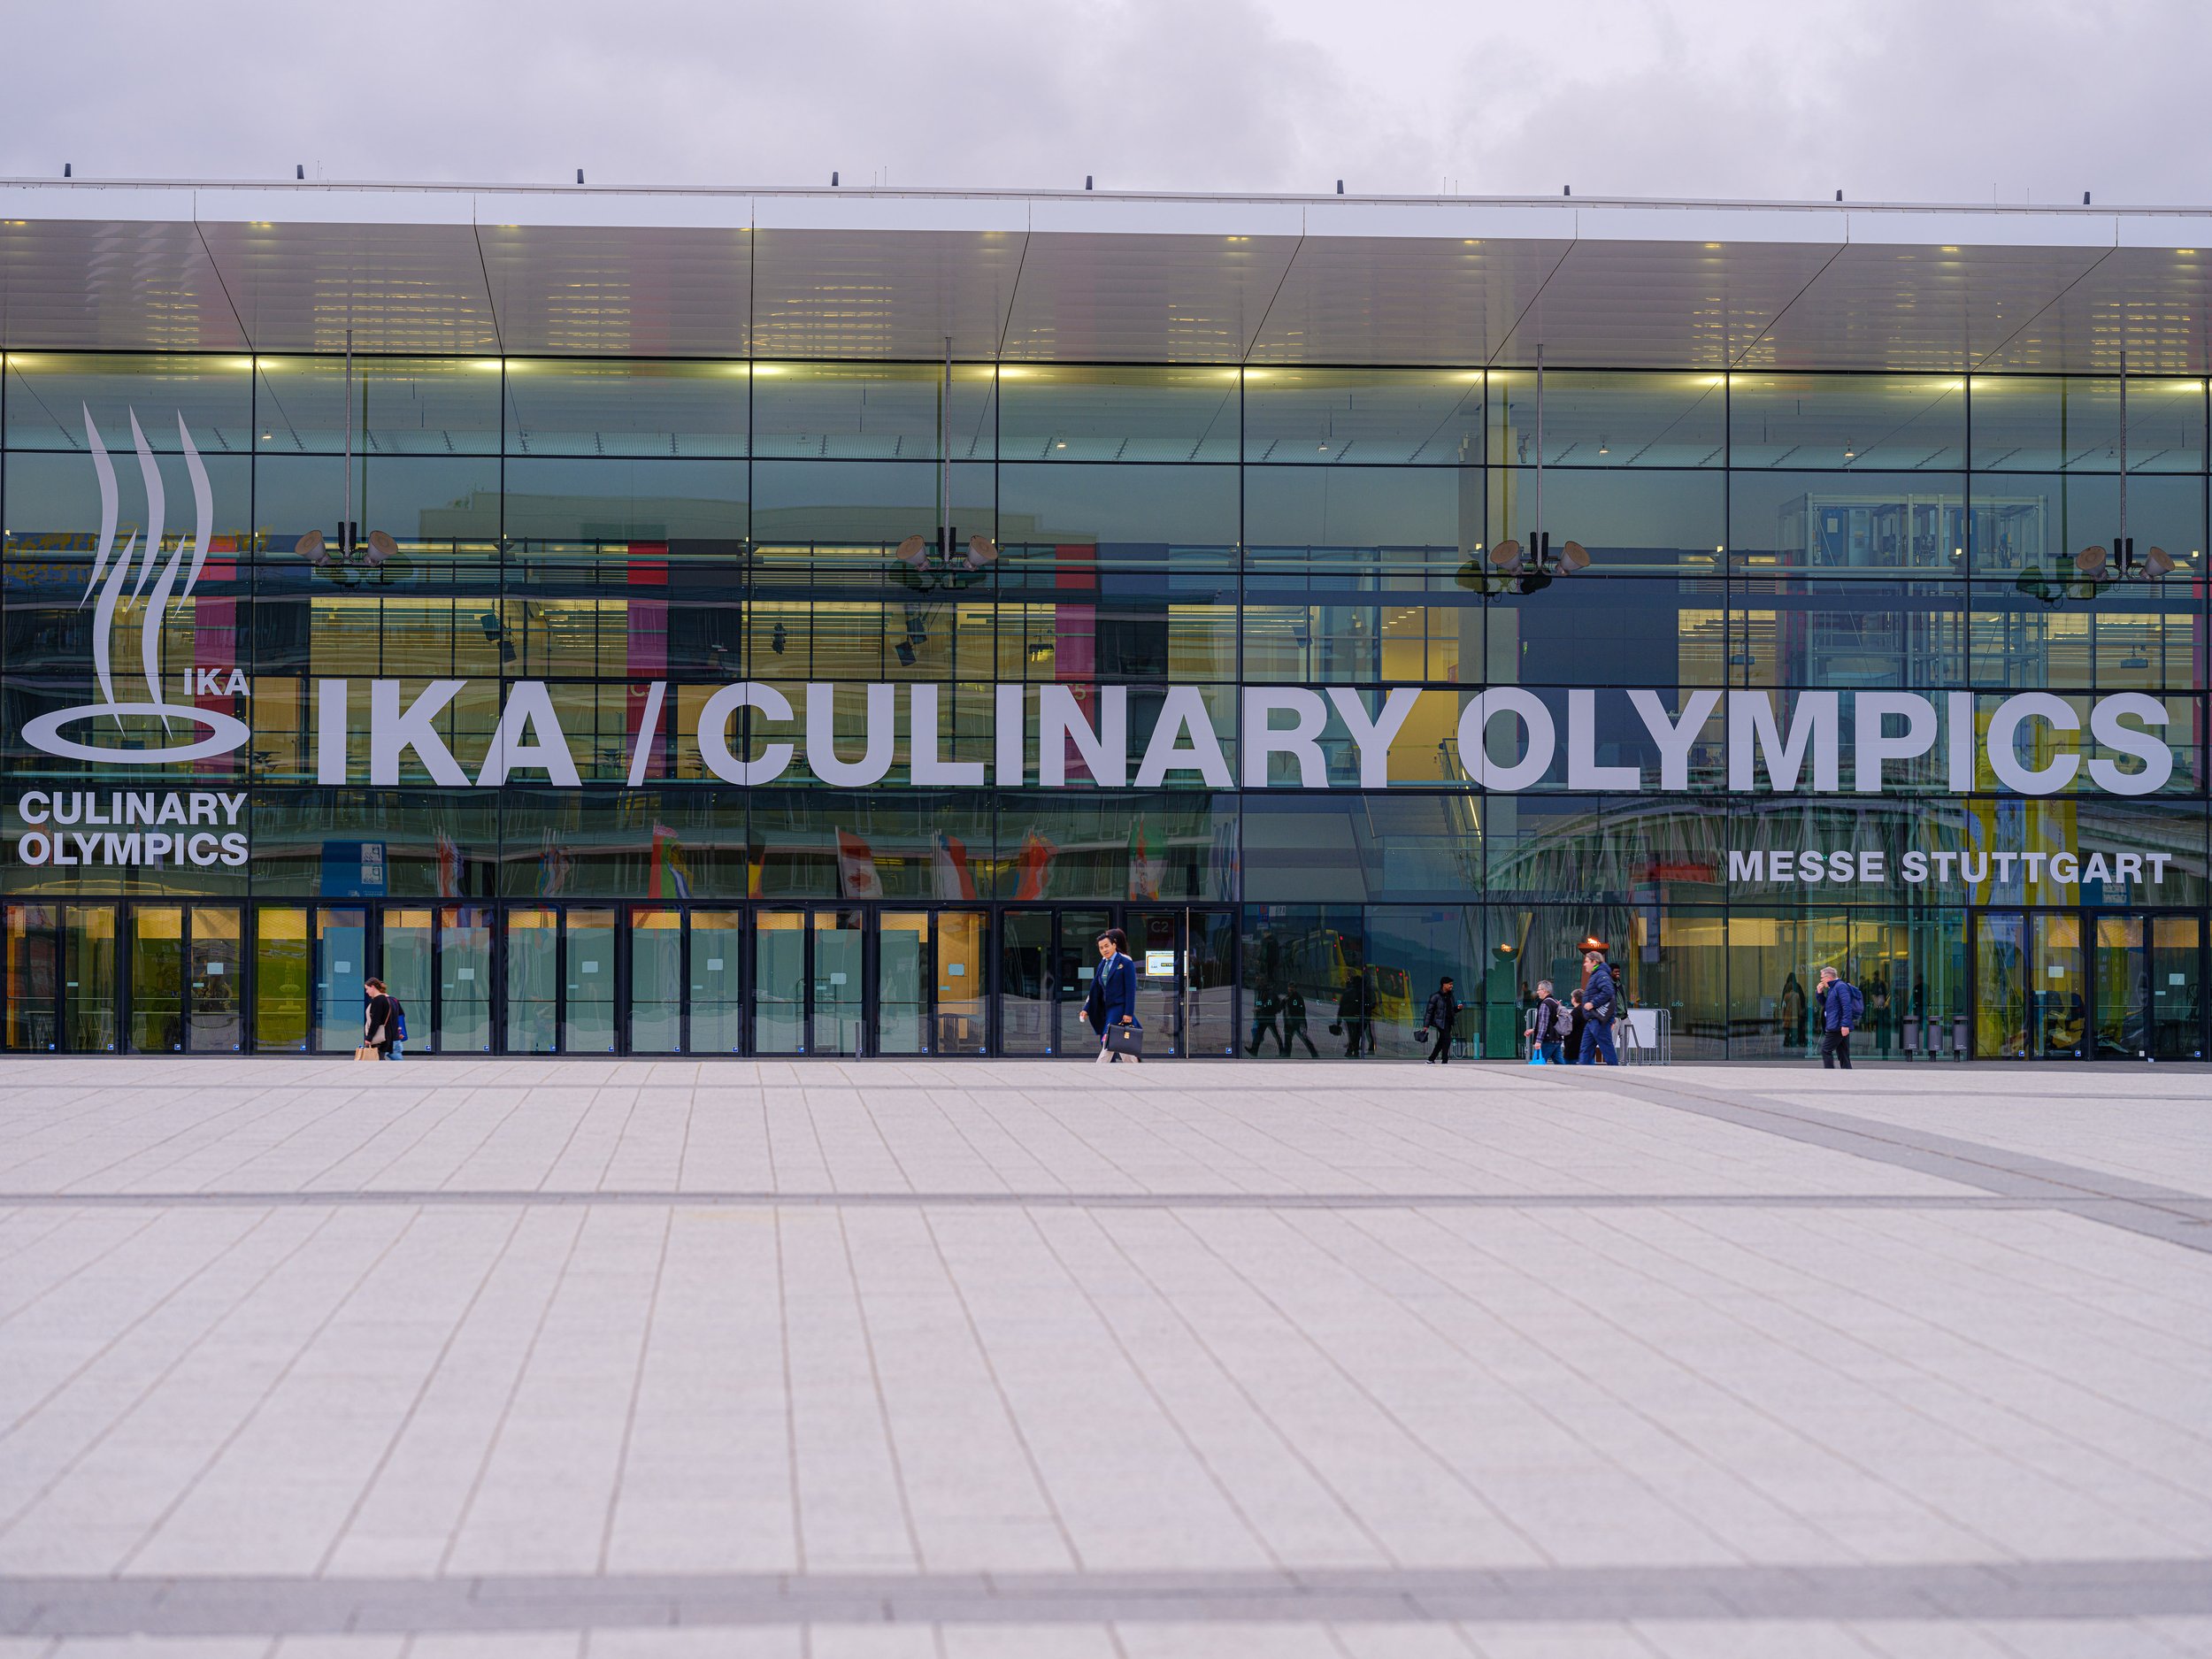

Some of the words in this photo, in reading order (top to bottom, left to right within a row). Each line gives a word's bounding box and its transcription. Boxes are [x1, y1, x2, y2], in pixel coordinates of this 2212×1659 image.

[184, 668, 251, 696] IKA
[319, 680, 582, 786] IKA
[627, 681, 667, 786] /
[697, 681, 1423, 788] CULINARY
[1457, 687, 2173, 795] OLYMPICS
[19, 792, 248, 826] CULINARY
[18, 833, 249, 865] OLYMPICS
[1729, 850, 1885, 882] MESSE
[1901, 850, 2172, 884] STUTTGART
[1151, 921, 1169, 933] C2
